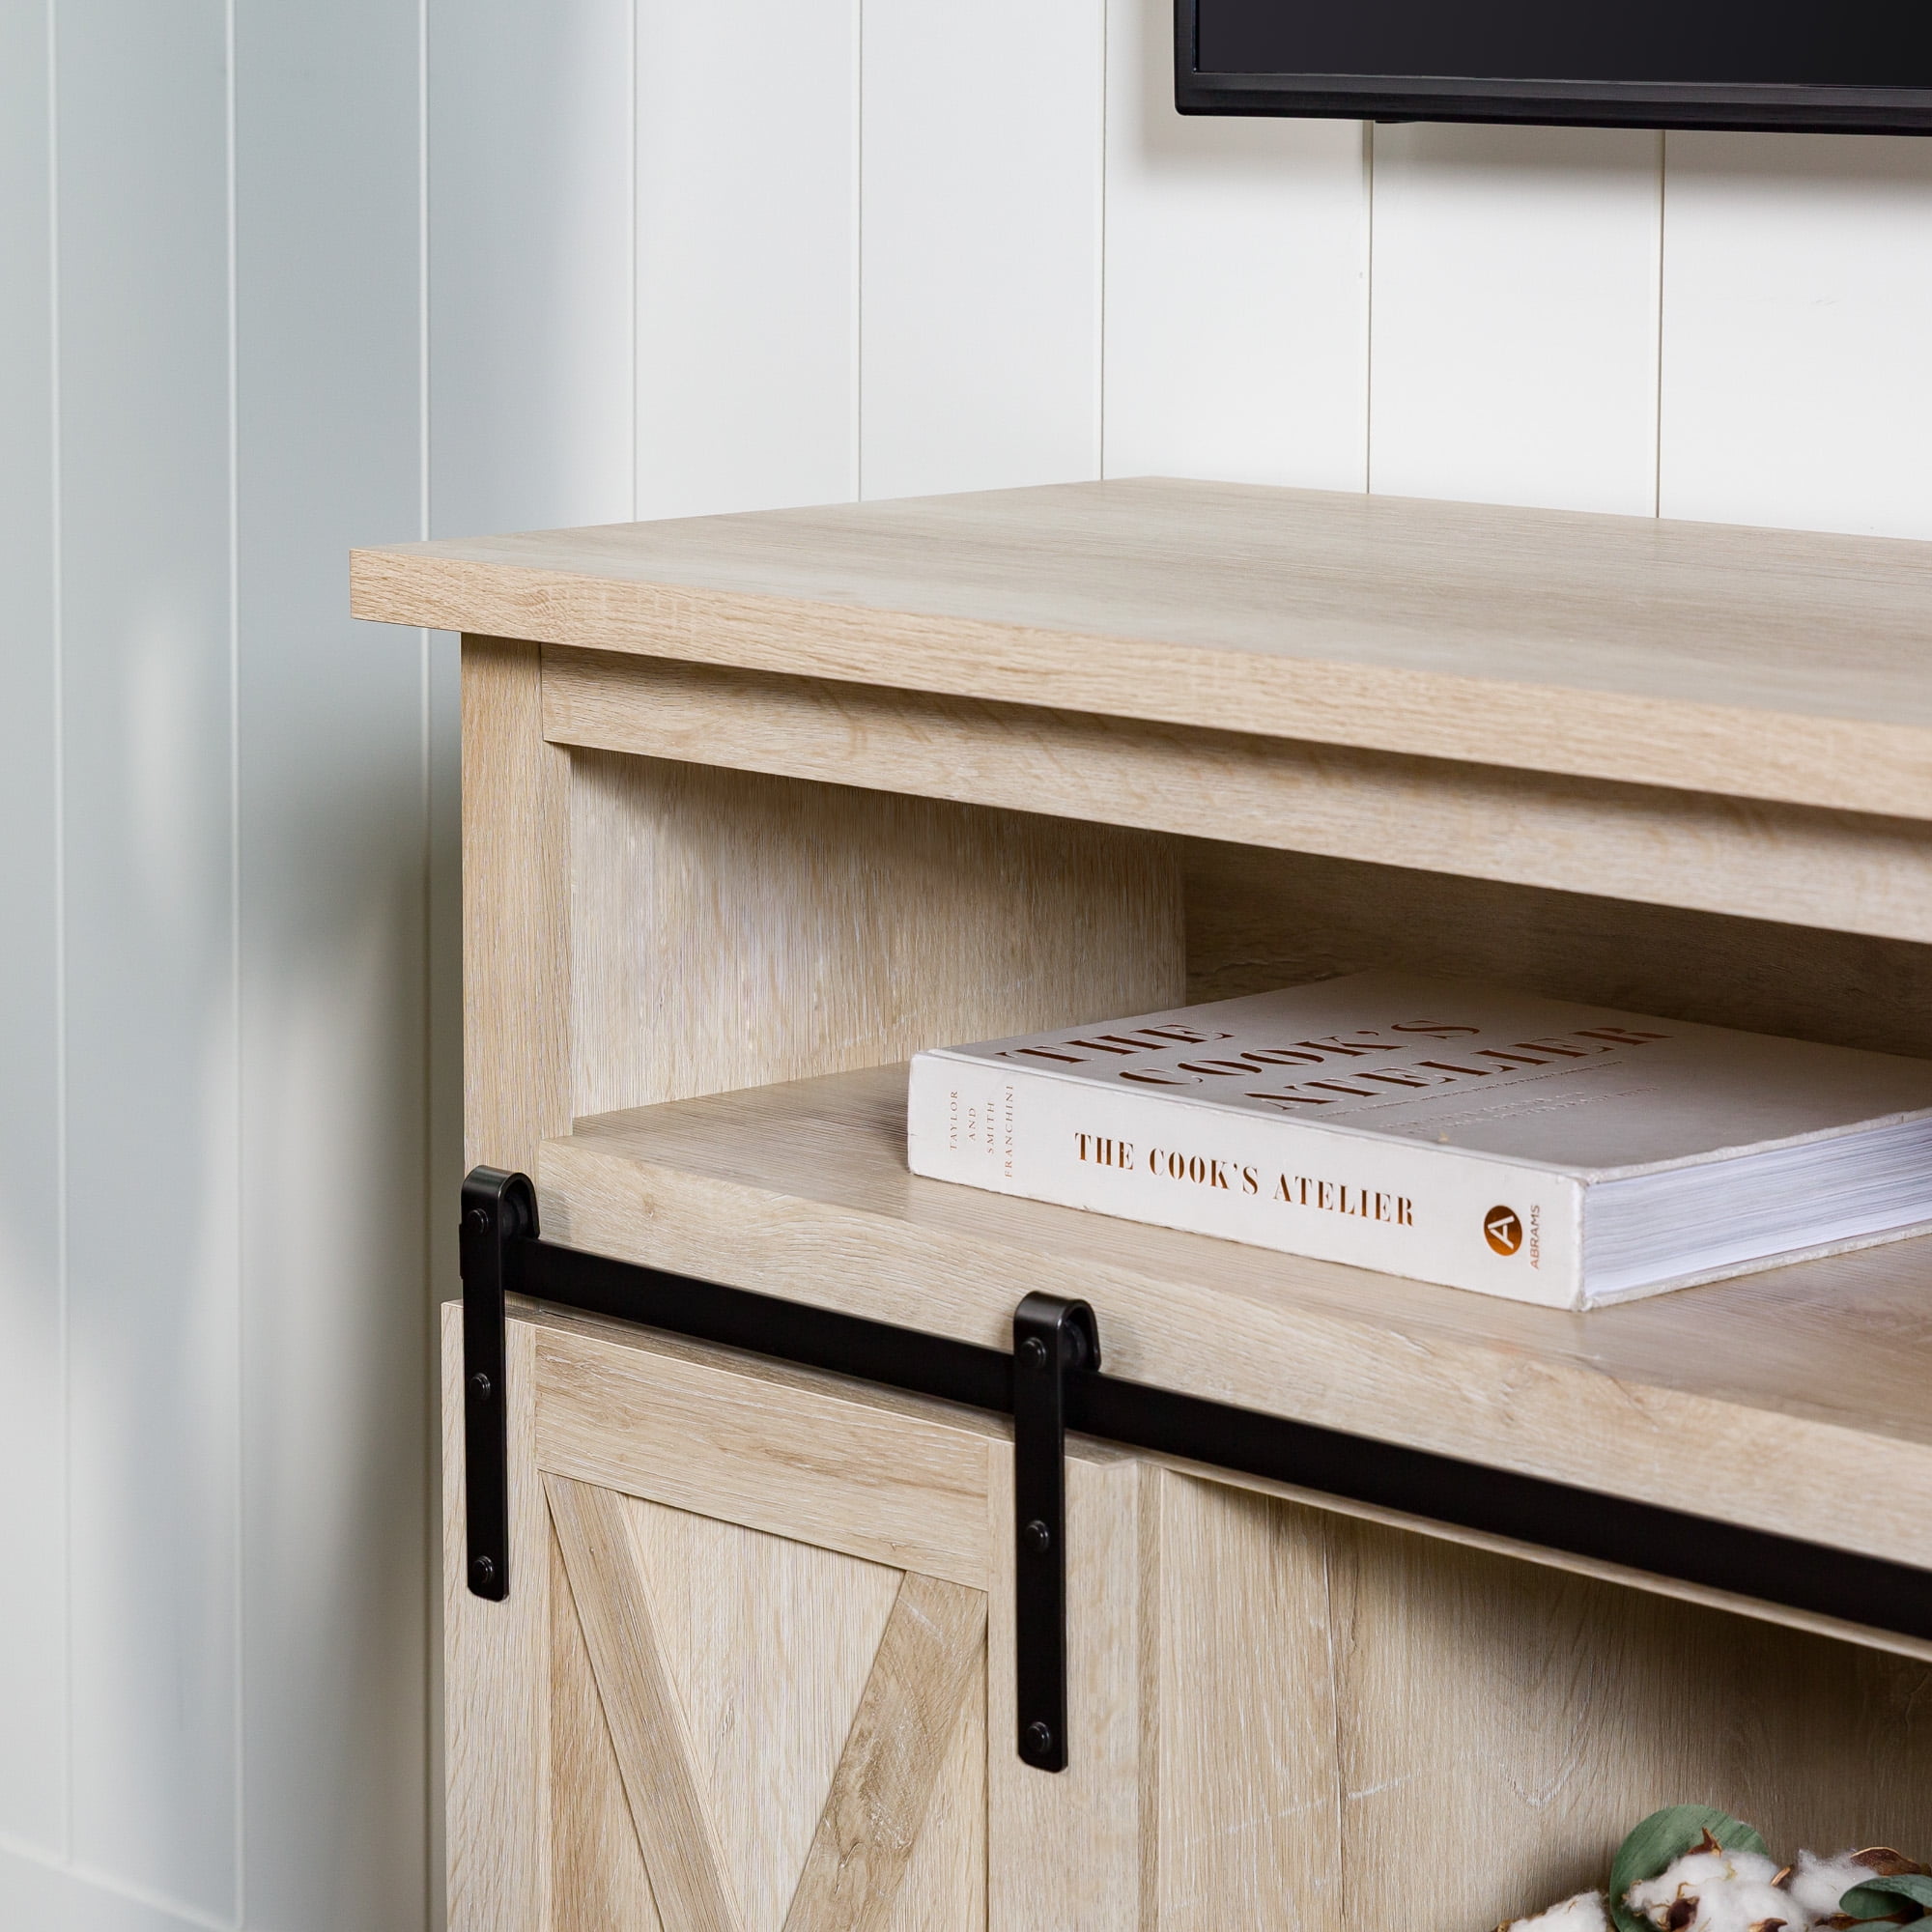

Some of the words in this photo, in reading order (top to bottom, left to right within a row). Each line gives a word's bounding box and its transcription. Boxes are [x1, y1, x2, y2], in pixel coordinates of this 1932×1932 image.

[995, 1023, 1236, 1064] THE
[1119, 1019, 1481, 1086] COOK'S
[1243, 1027, 1677, 1111] ATELIER
[949, 1090, 959, 1151] TAYLOR
[968, 1107, 977, 1142] AND
[986, 1101, 995, 1154] SMITH
[1004, 1085, 1013, 1179] FRANCHINI
[1074, 1132, 1135, 1171] THE
[1148, 1148, 1259, 1196] COOK'S
[1273, 1173, 1415, 1228] ATELIER
[1530, 1204, 1541, 1270] ABRAMS
